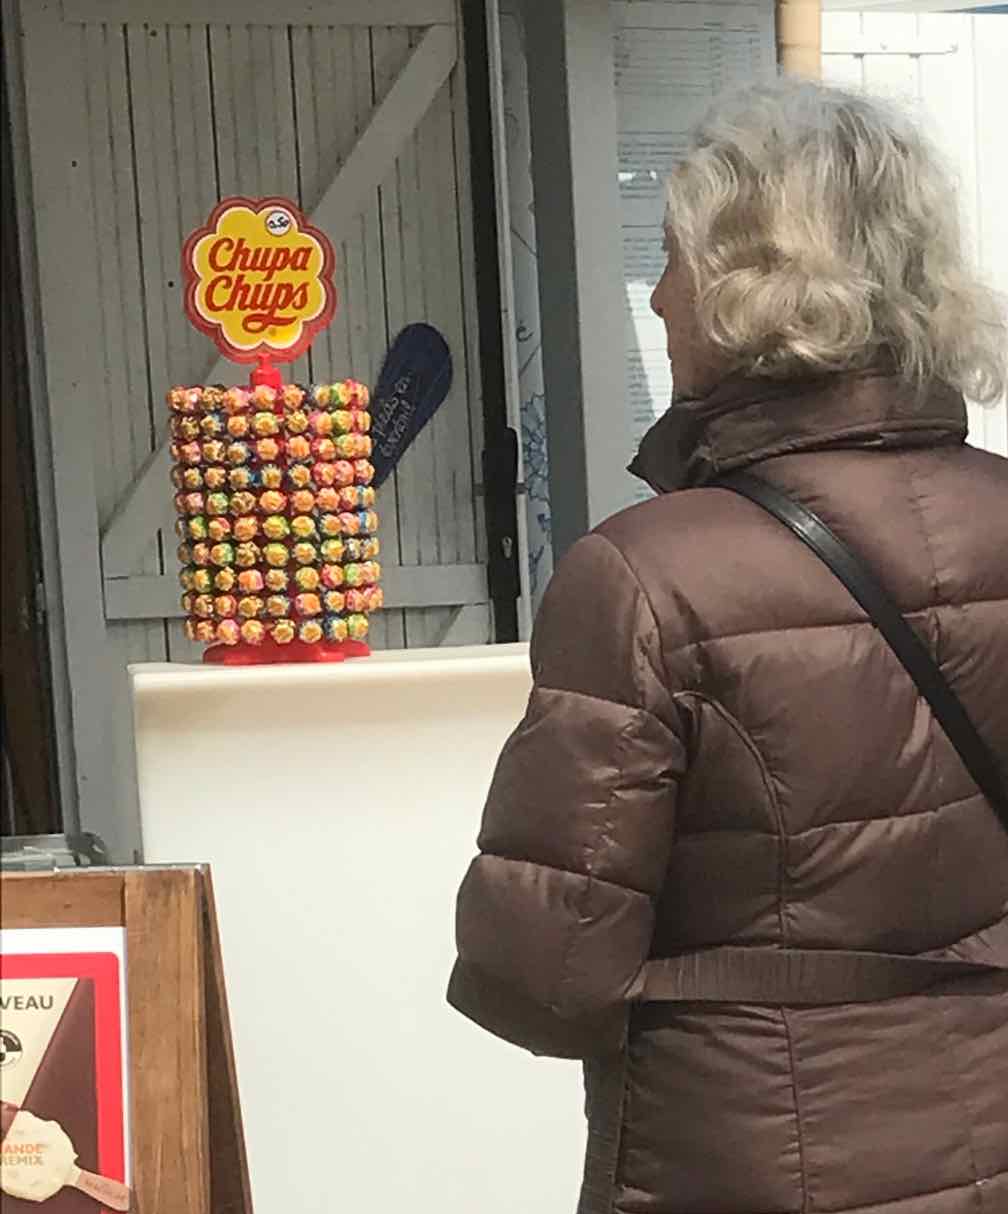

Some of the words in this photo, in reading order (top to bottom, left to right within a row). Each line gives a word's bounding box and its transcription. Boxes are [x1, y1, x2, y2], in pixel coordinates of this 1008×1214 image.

[208, 237, 313, 281] Chupa
[205, 274, 310, 333] Chups
[0, 995, 53, 1010] VEAU
